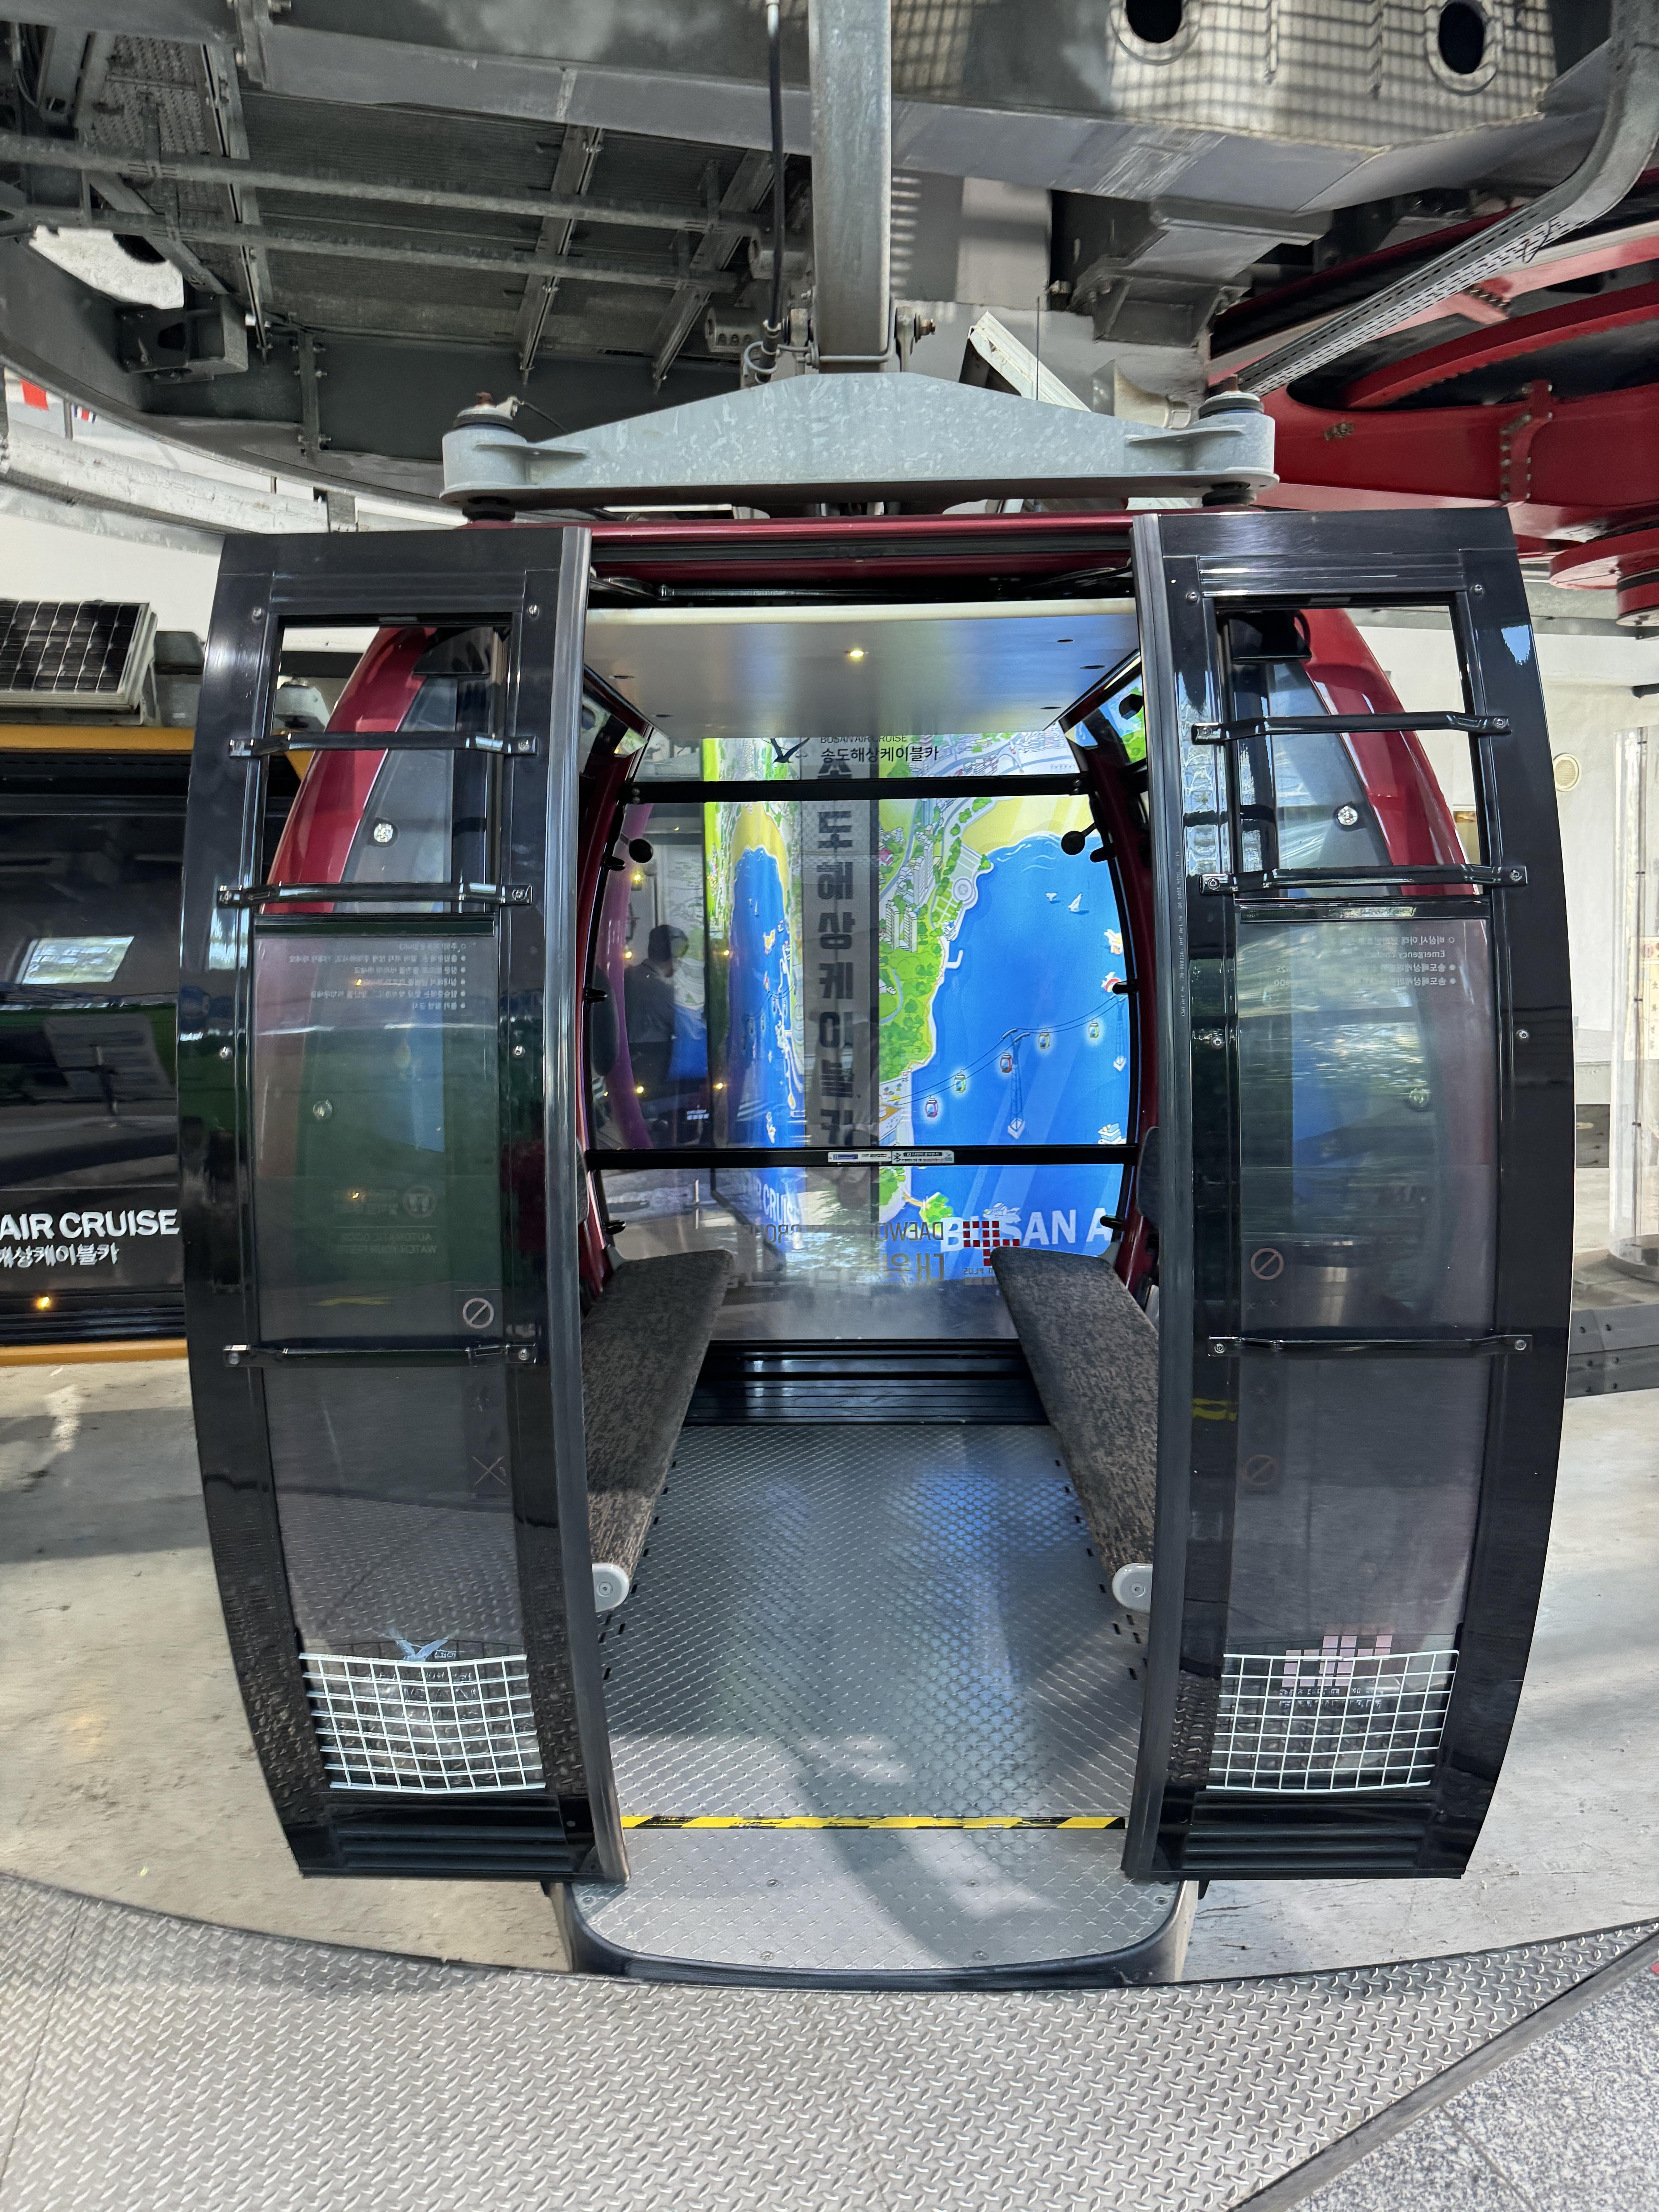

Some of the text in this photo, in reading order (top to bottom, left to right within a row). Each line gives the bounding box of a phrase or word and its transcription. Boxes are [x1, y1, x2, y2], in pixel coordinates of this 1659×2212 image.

[821, 746, 939, 763] 송도해상케이블카
[0, 1209, 180, 1240] AIR CRUISE
